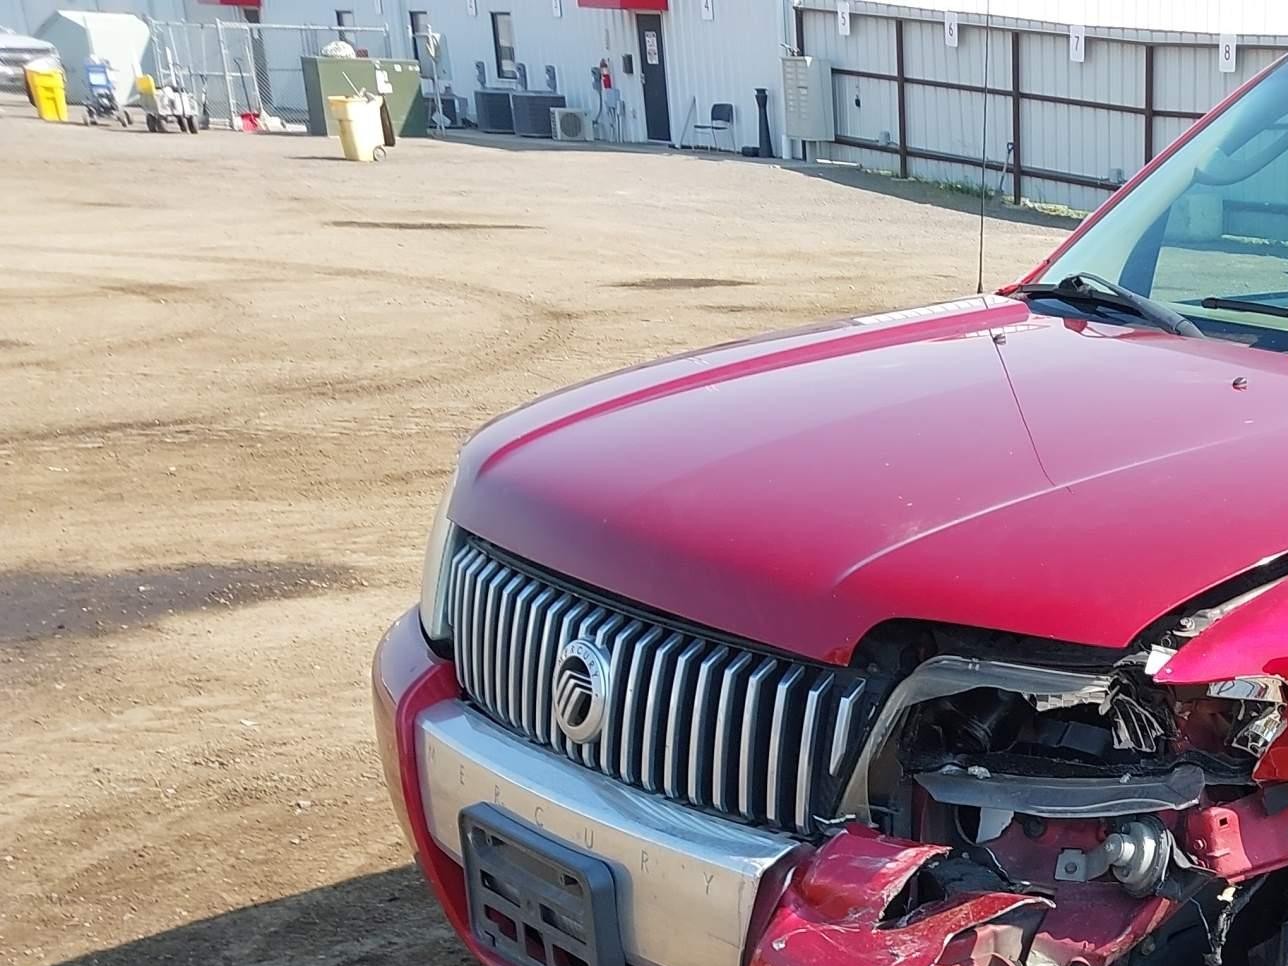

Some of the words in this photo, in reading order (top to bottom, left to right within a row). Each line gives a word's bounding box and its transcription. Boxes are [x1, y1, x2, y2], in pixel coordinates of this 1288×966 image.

[840, 12, 847, 26] 5
[948, 22, 955, 37] 6
[1073, 36, 1081, 51] 7
[1223, 44, 1231, 60] 8
[557, 644, 600, 678] MERCURY
[427, 743, 715, 895] MERCURY
